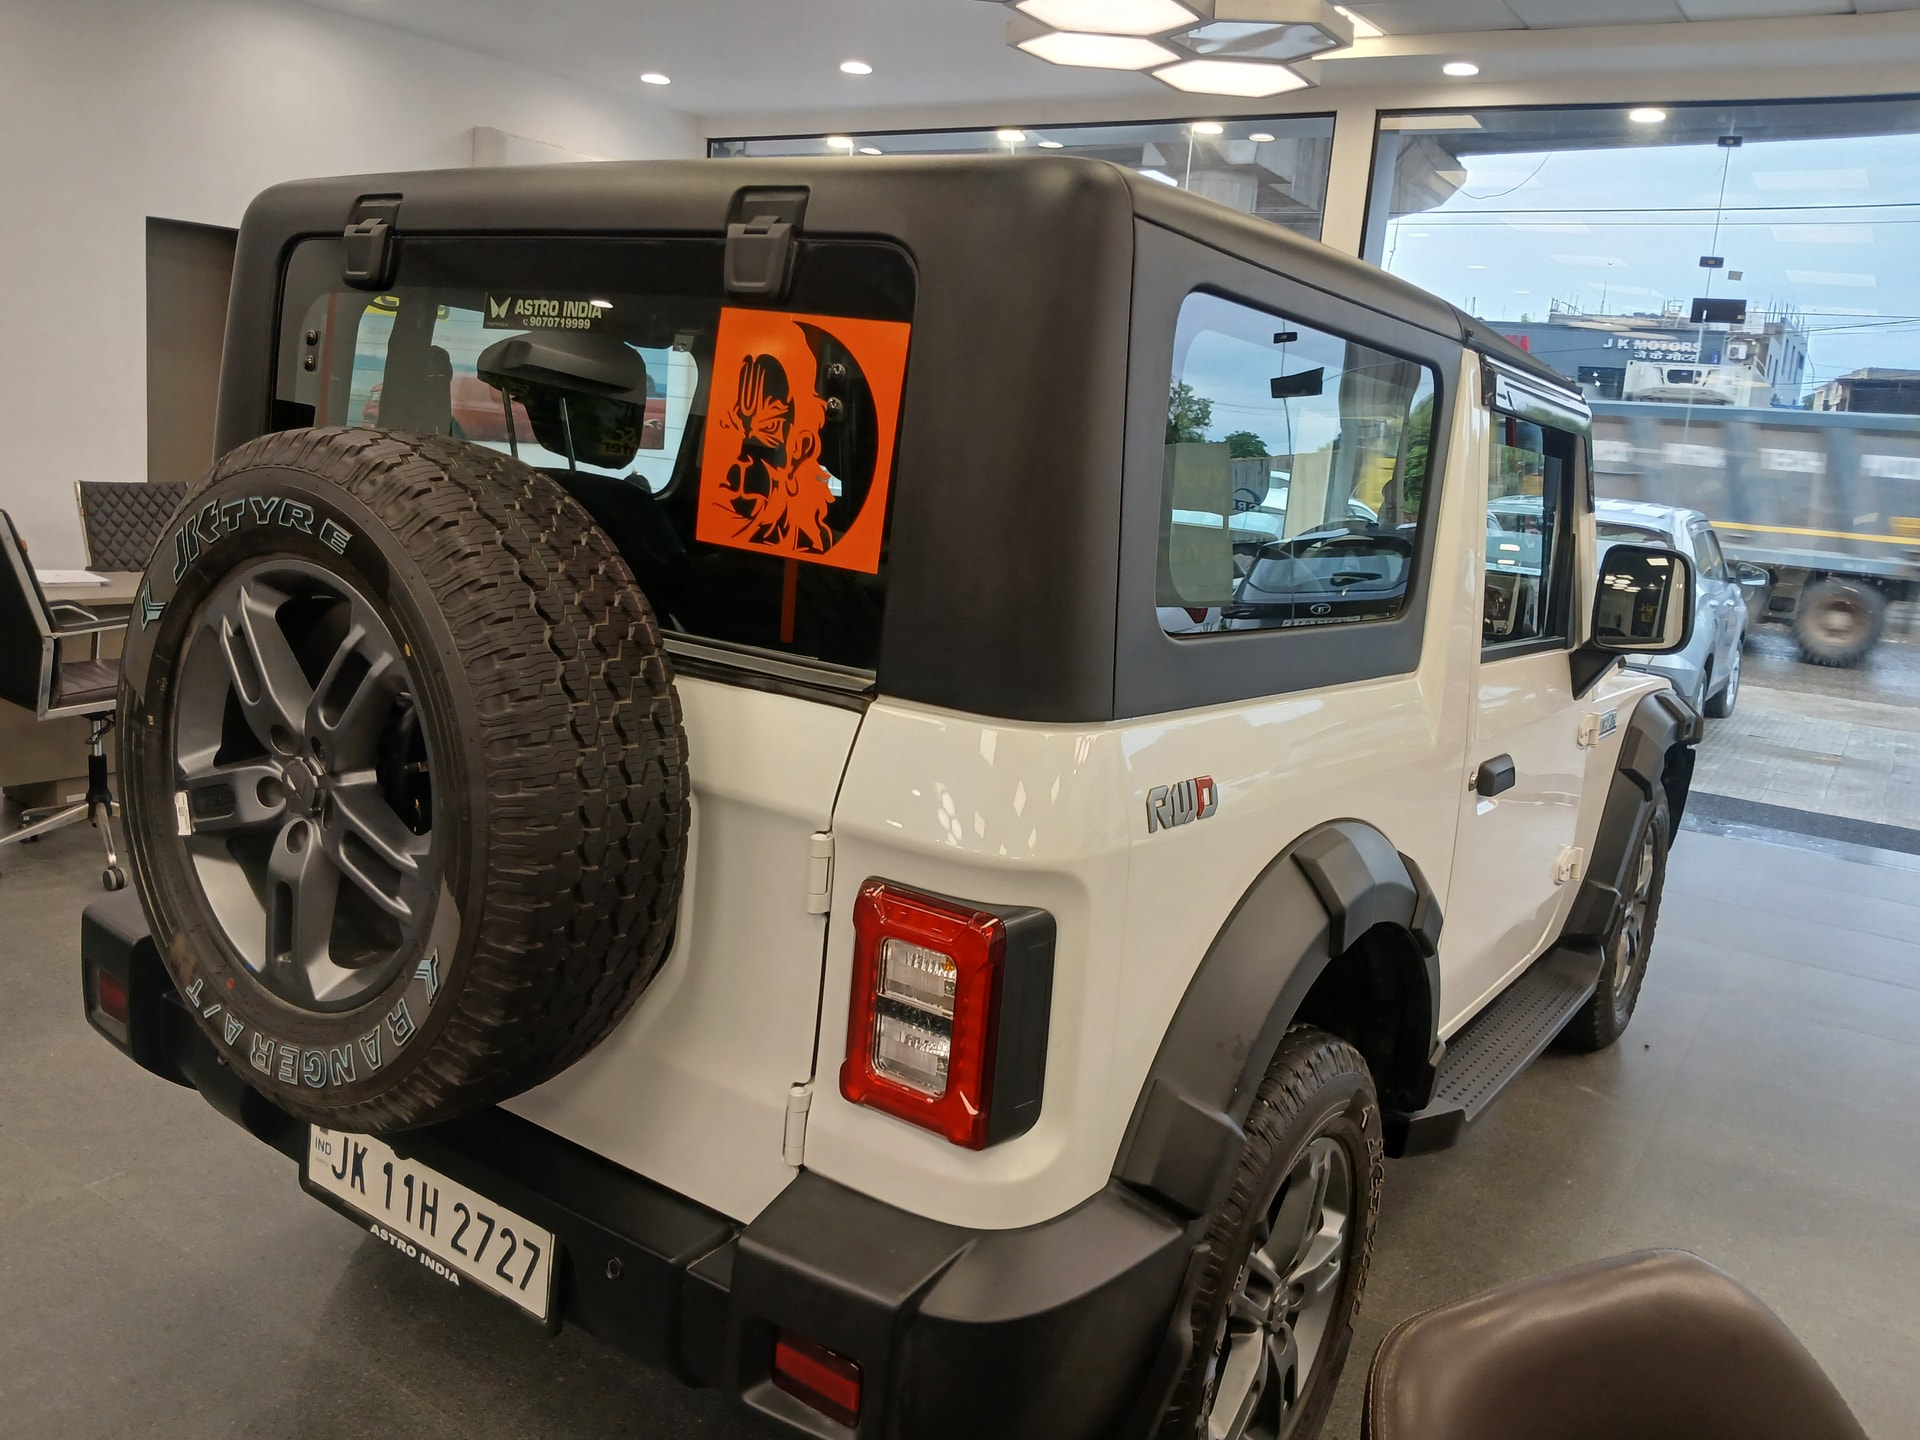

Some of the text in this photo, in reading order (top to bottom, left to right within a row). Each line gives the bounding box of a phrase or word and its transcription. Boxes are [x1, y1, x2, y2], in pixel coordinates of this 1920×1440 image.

[514, 299, 602, 319] ASTRO INDIA
[529, 316, 591, 329] 9070719999
[1602, 338, 1703, 353] J K MOTORS
[1146, 774, 1218, 834] RWD
[250, 998, 417, 1088] RANGER
[314, 1136, 332, 1157] IND
[331, 1136, 541, 1292] JK 11H 2727
[369, 1223, 461, 1287] ASTRO INDIA
